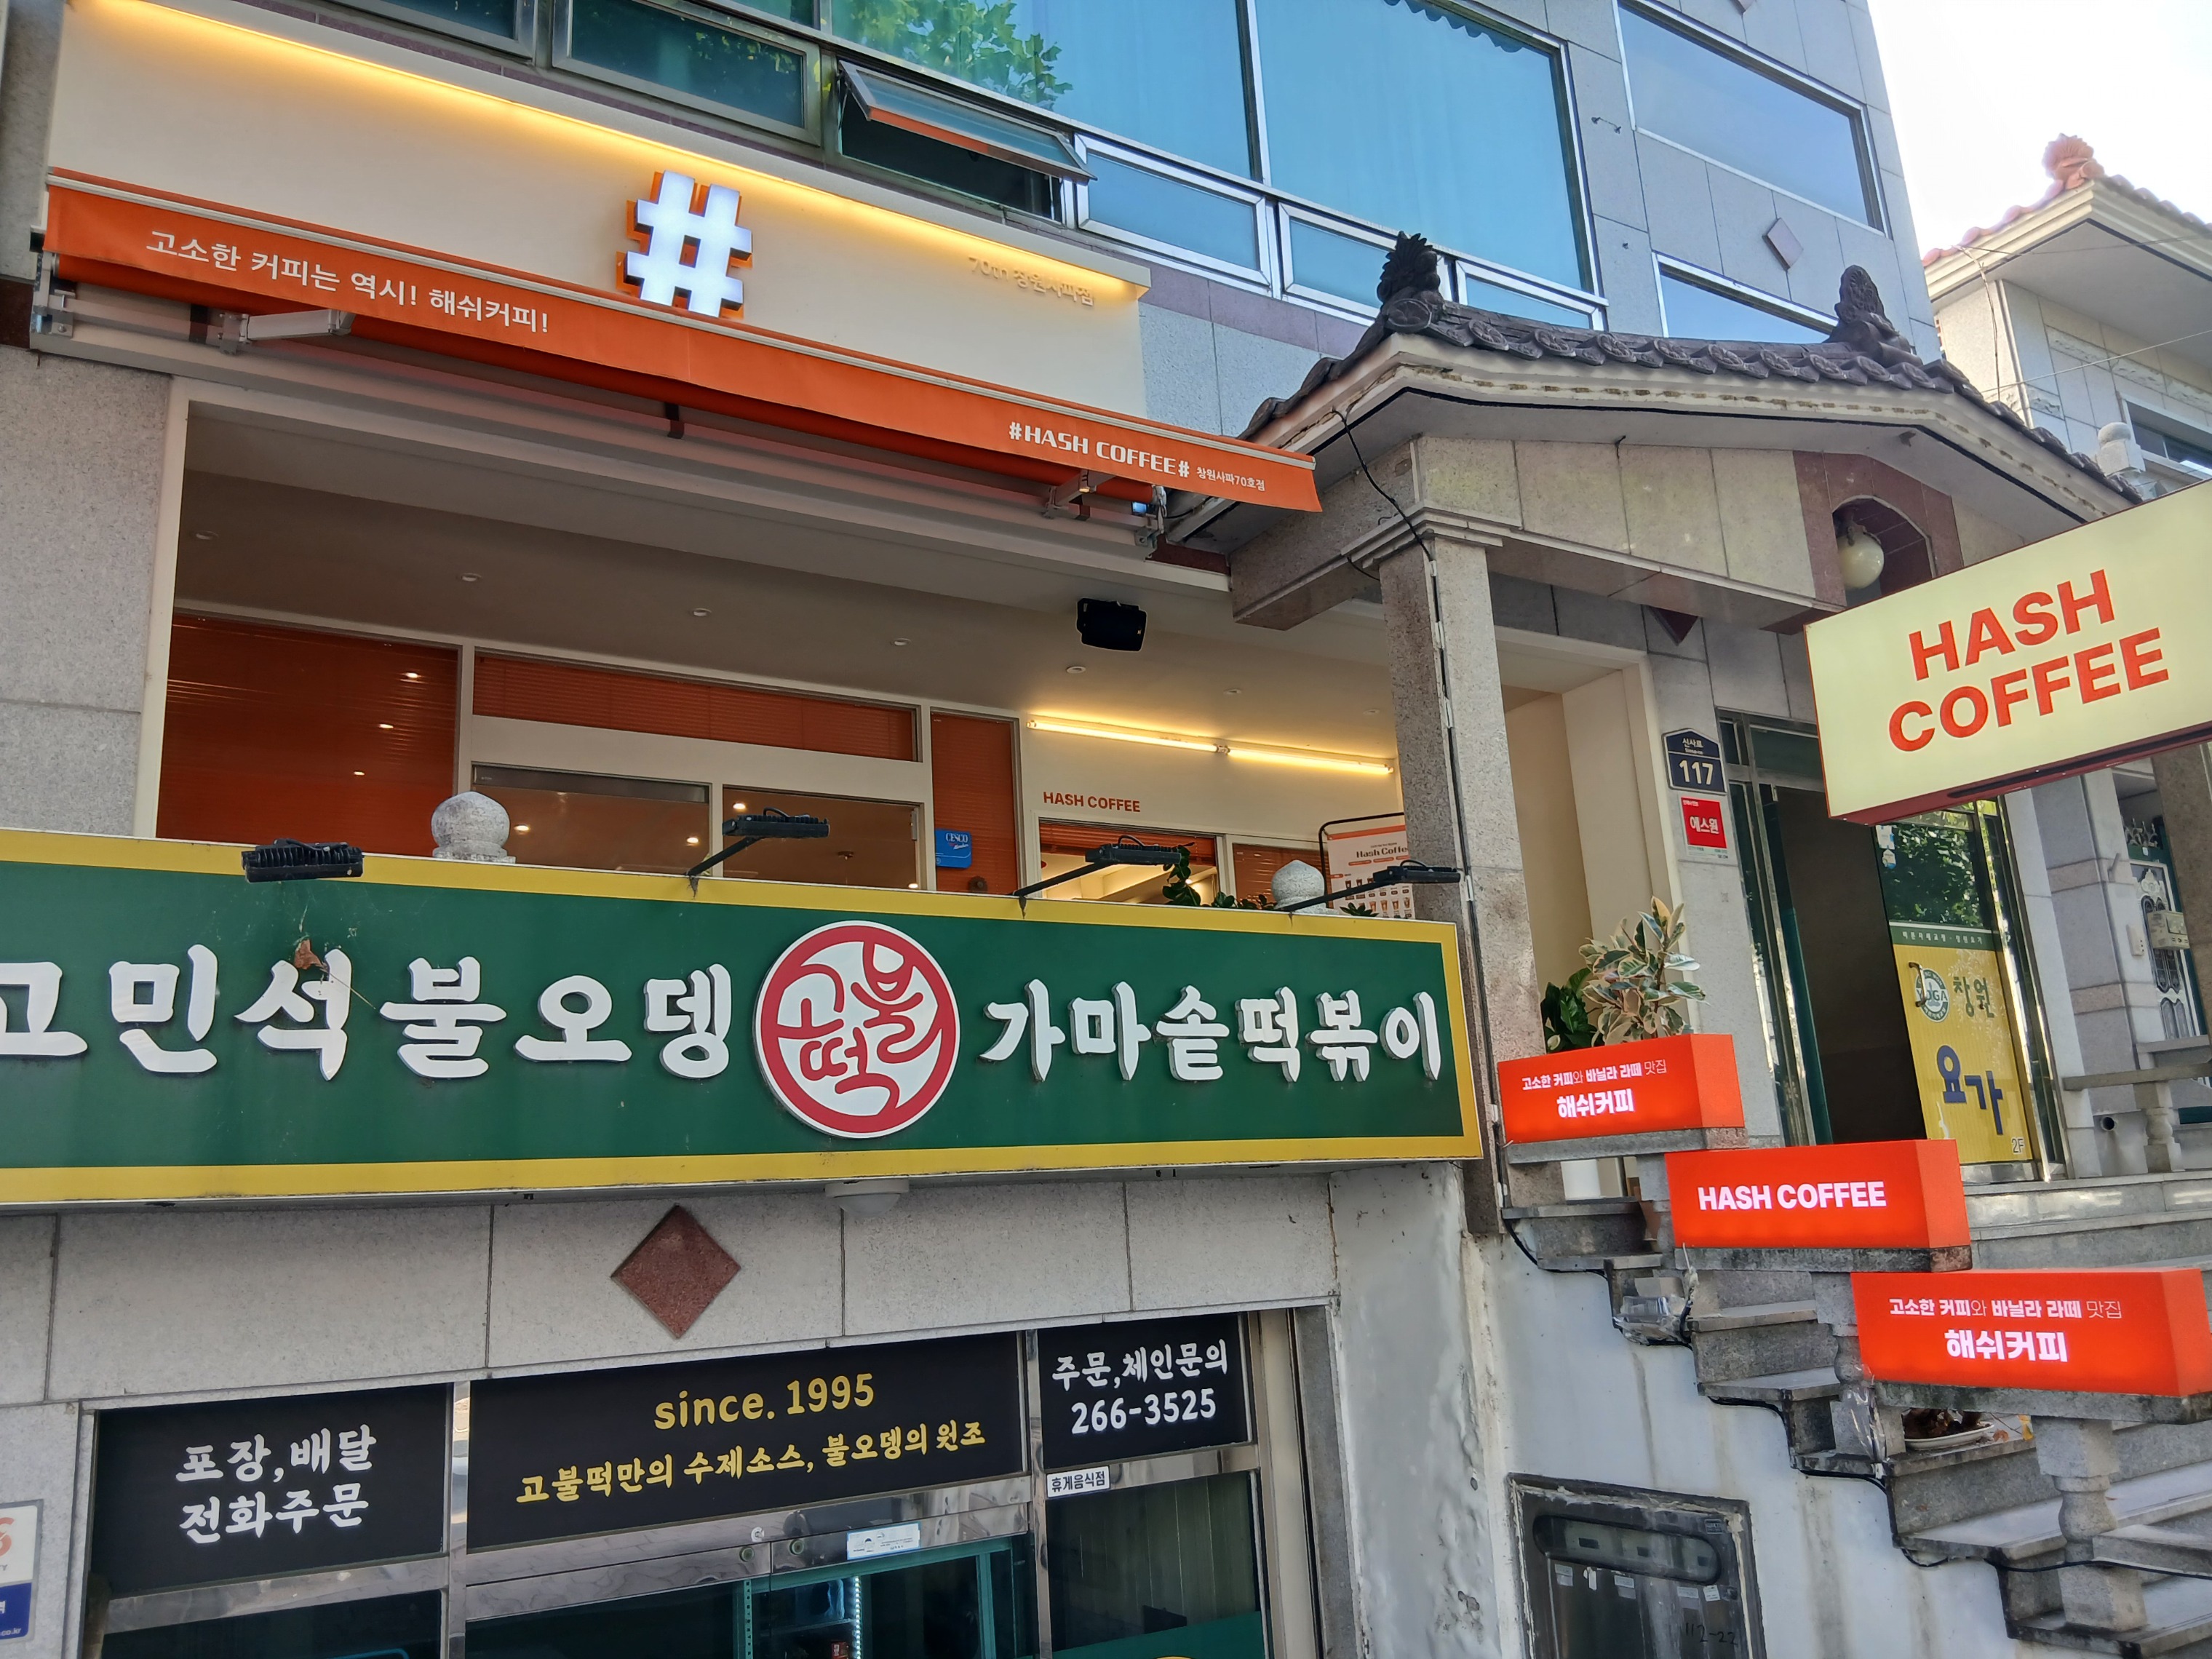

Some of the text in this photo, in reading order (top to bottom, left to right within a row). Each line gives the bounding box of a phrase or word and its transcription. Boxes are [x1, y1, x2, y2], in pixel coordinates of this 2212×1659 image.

[146, 231, 549, 333] 고소한 커피는 역시! 해쉬커피!
[1008, 421, 1190, 477] #HASH COFFEE#
[1196, 466, 1265, 491] 창원사파70호점
[1909, 569, 2115, 681] HASH
[1889, 627, 2169, 752] COFFEE
[1682, 738, 1704, 748] 신사로
[1679, 760, 1714, 785] 117
[1043, 791, 1141, 813] HASH COFFEE
[945, 832, 968, 843] CESCO
[1690, 816, 1719, 834] 에스원
[1356, 849, 1380, 858] Hash
[1953, 976, 1994, 1019] 창원
[1521, 1059, 1667, 1091] 고소한 커피와 바닐라 라떼 맛집
[1937, 1045, 2003, 1135] 요가
[1556, 1089, 1635, 1118] 해쉬커피
[2011, 1138, 2025, 1153] 2F
[1698, 1181, 1887, 1210] HASH COFFEE
[1889, 1298, 2123, 1319] 고소한 커피와 바닐라 라떼 맛집
[1944, 1329, 2069, 1363] 해쉬커피
[653, 1372, 875, 1431] since. 1995
[1071, 1388, 1216, 1434] 266-3525
[515, 1420, 985, 1504] 고불떡만의 수제소스, 불오뎅의 원조
[1051, 1471, 1105, 1492] 휴게음식점
[179, 1482, 369, 1544] 전화주문
